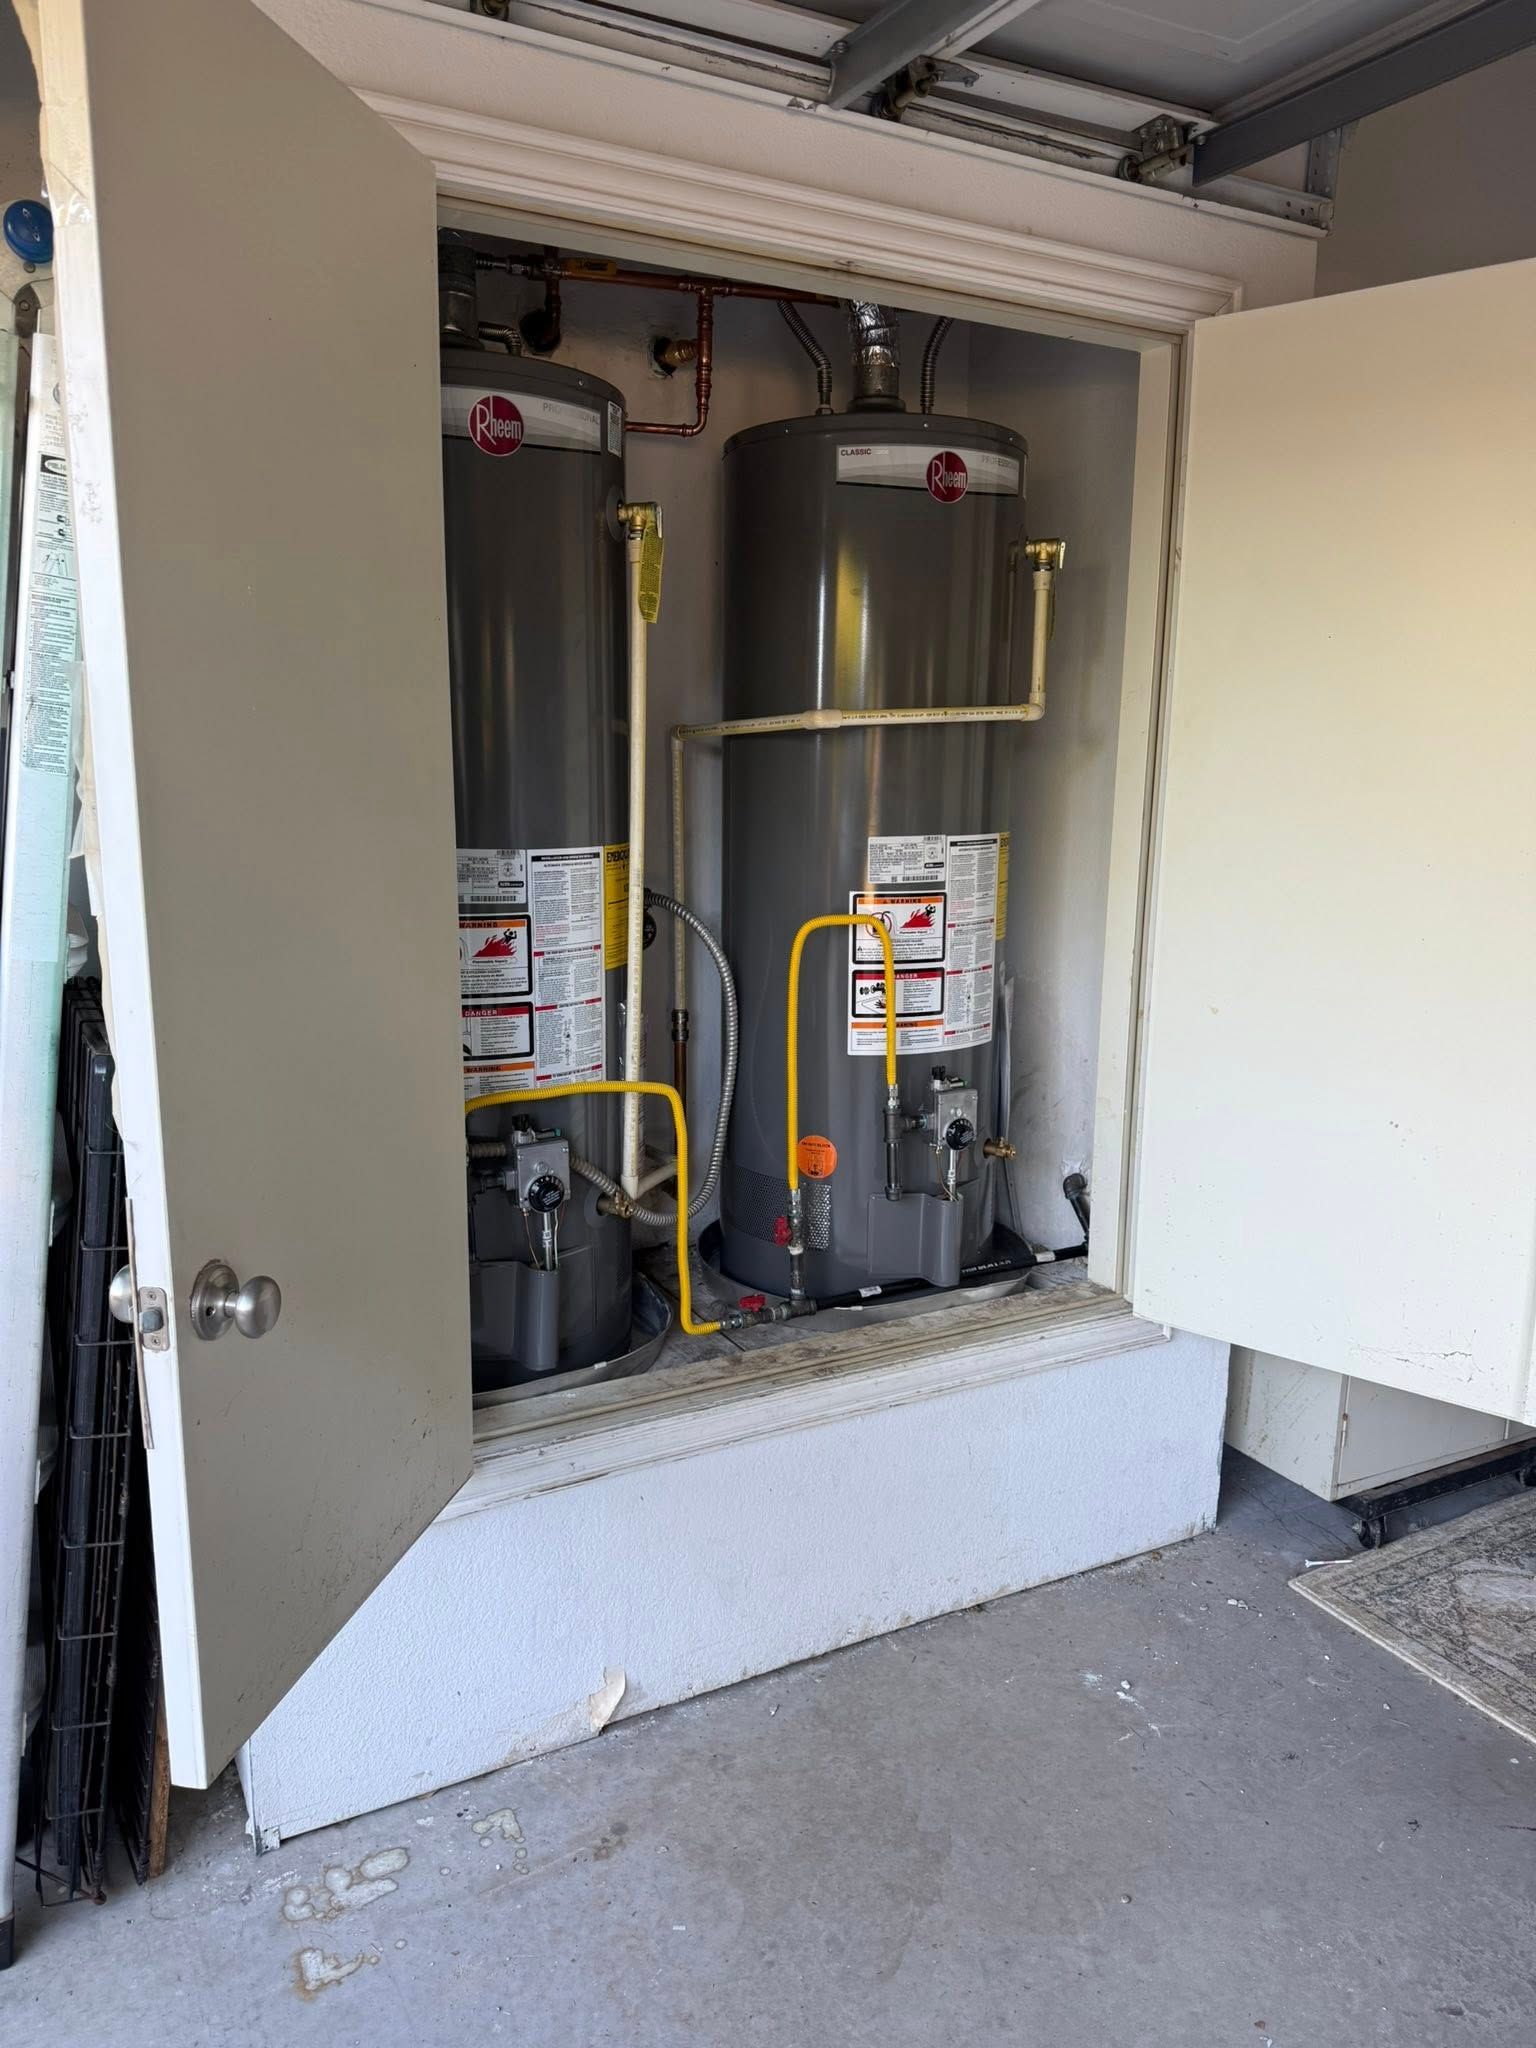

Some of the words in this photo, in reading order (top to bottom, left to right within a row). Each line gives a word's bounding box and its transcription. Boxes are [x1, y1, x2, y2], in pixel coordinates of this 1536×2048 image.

[475, 396, 522, 446] Rheem
[840, 447, 872, 458] CLASSIC
[931, 451, 967, 495] Rheem
[464, 1009, 498, 1017] DANGER
